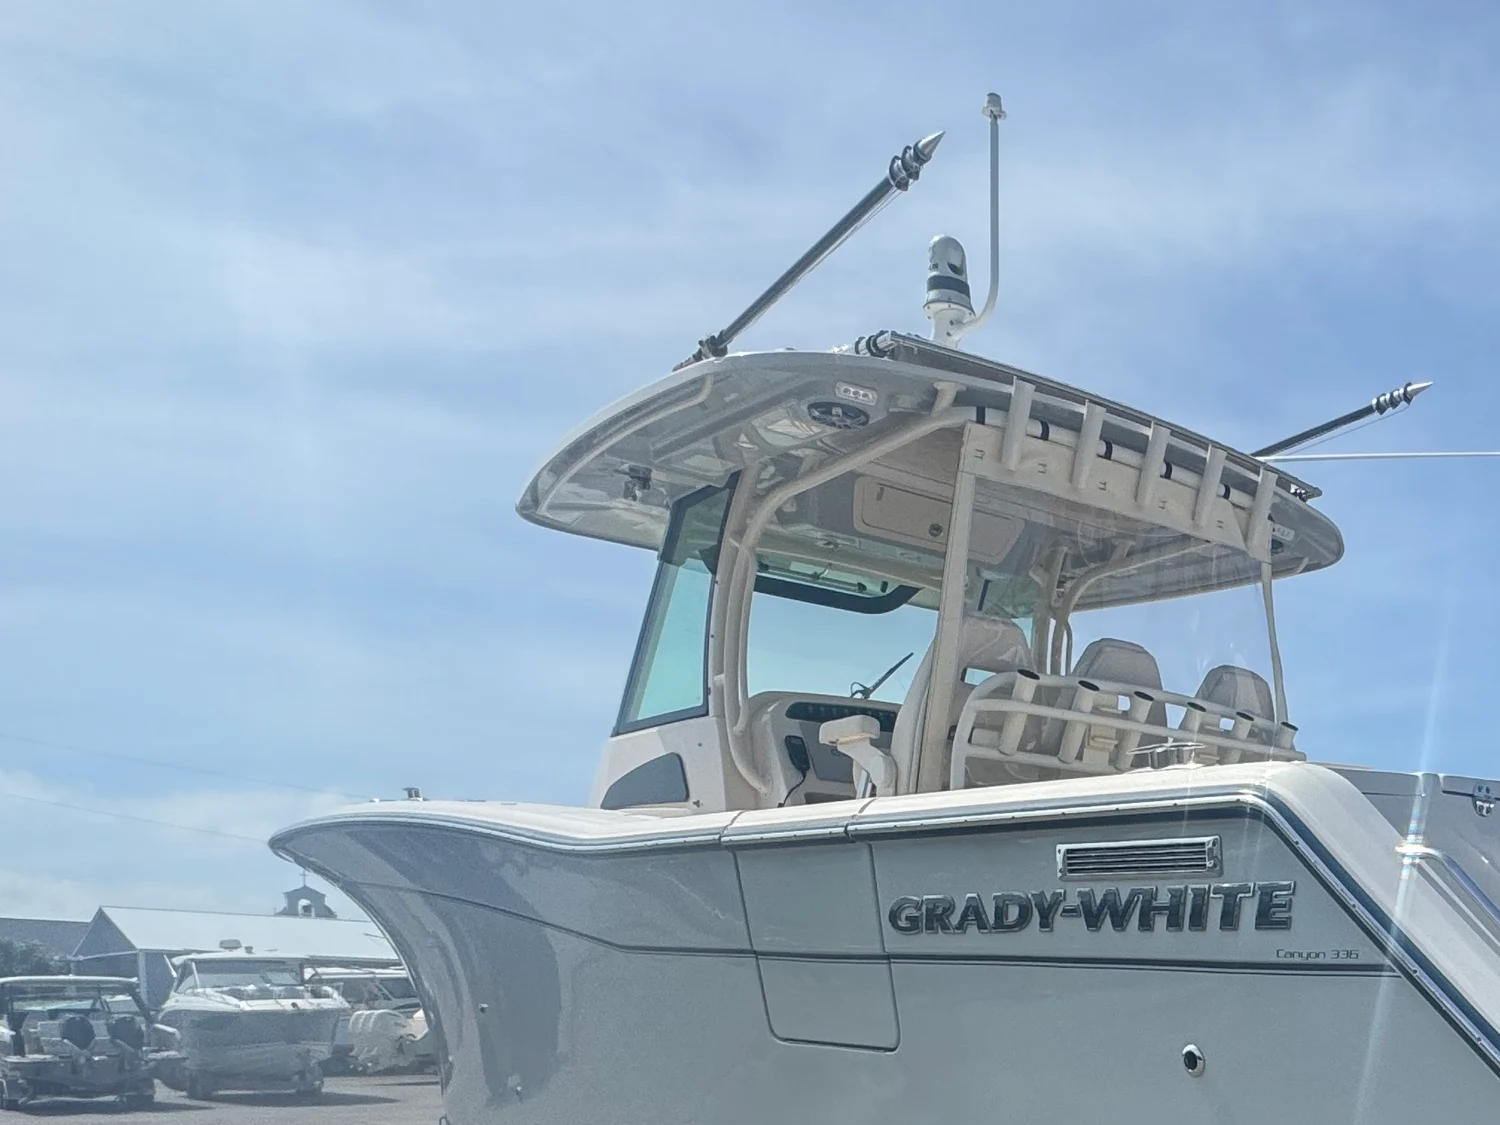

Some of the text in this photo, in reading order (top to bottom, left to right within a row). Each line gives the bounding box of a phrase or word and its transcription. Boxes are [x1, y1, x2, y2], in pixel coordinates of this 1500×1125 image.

[888, 881, 1296, 934] GRADY-WHITE
[1276, 949, 1359, 961] Canyon 336
